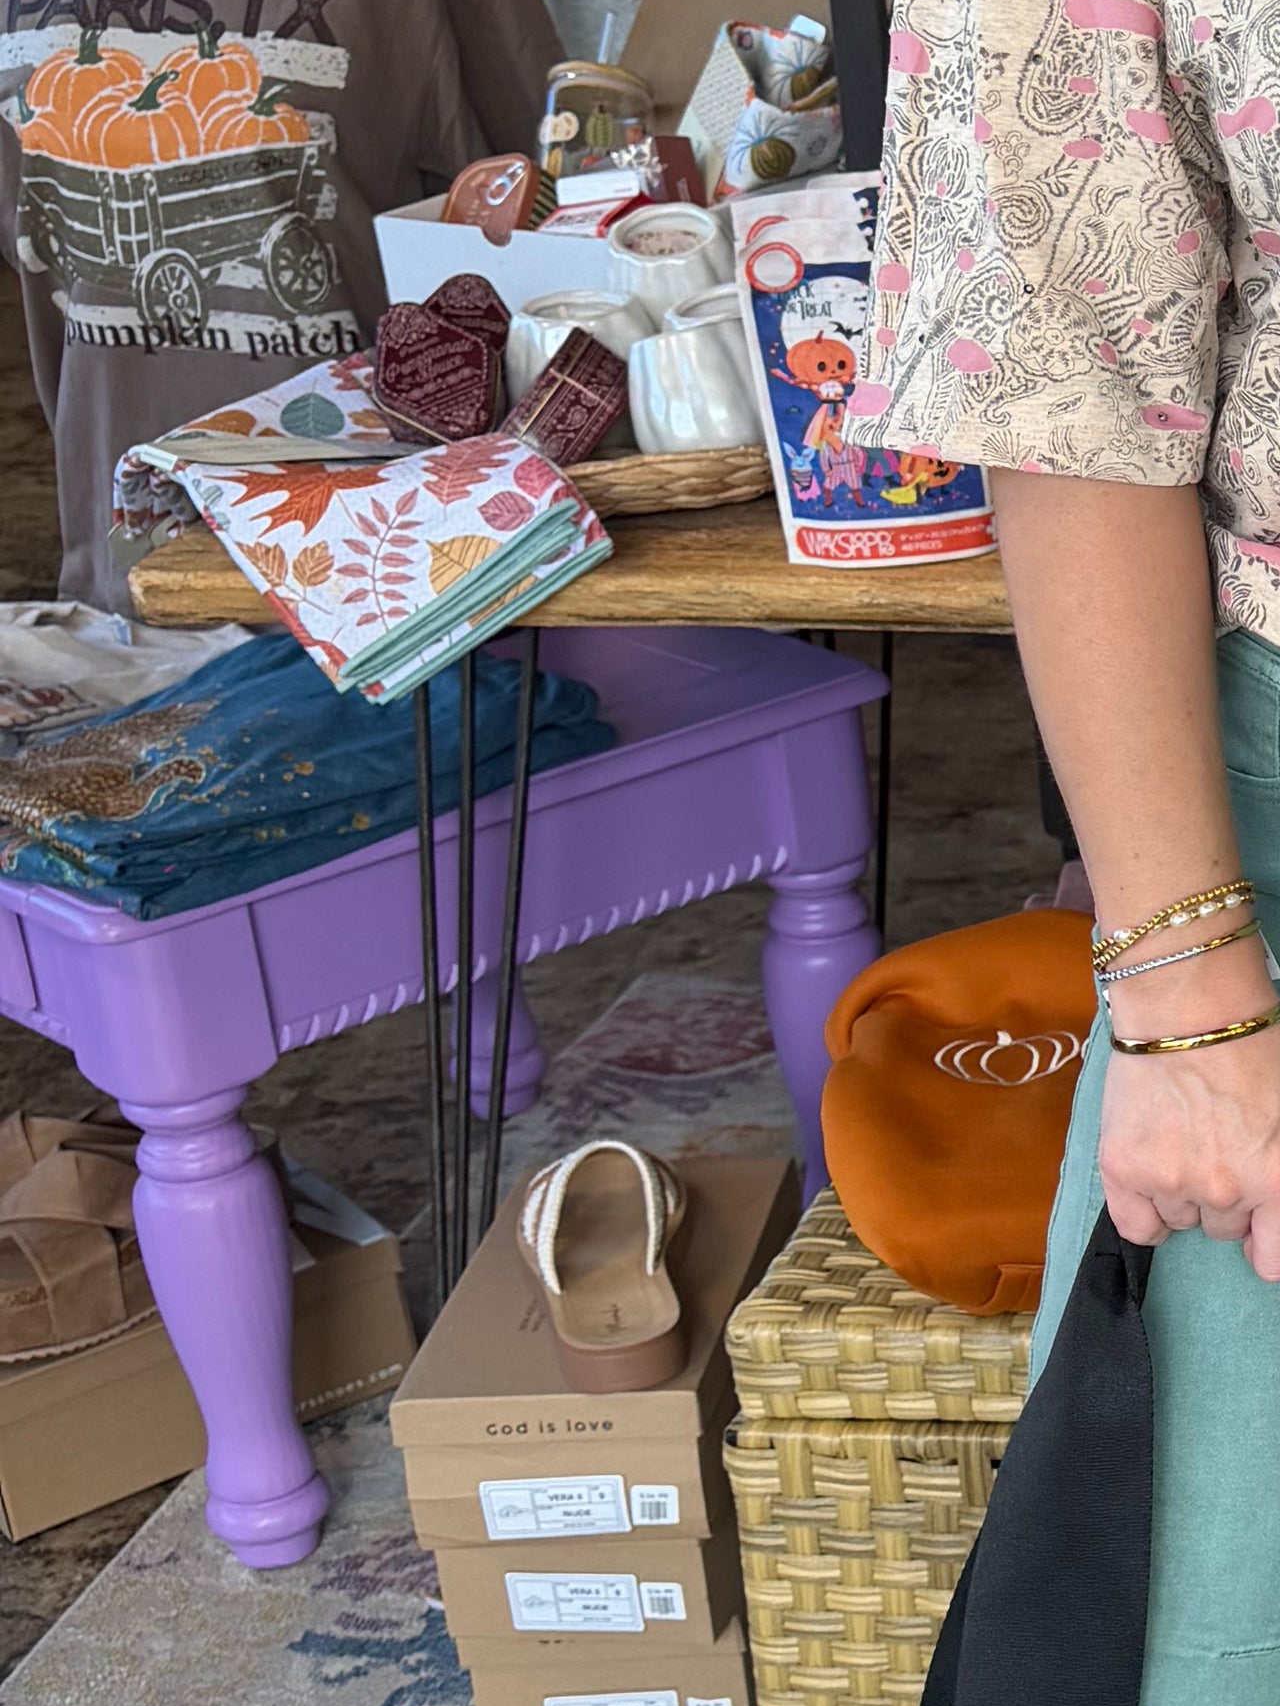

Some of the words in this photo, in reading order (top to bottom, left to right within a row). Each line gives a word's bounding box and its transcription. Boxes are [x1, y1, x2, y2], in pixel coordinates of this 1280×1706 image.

[245, 319, 363, 362] patch
[539, 1420, 556, 1434] is
[566, 1419, 614, 1433] love
